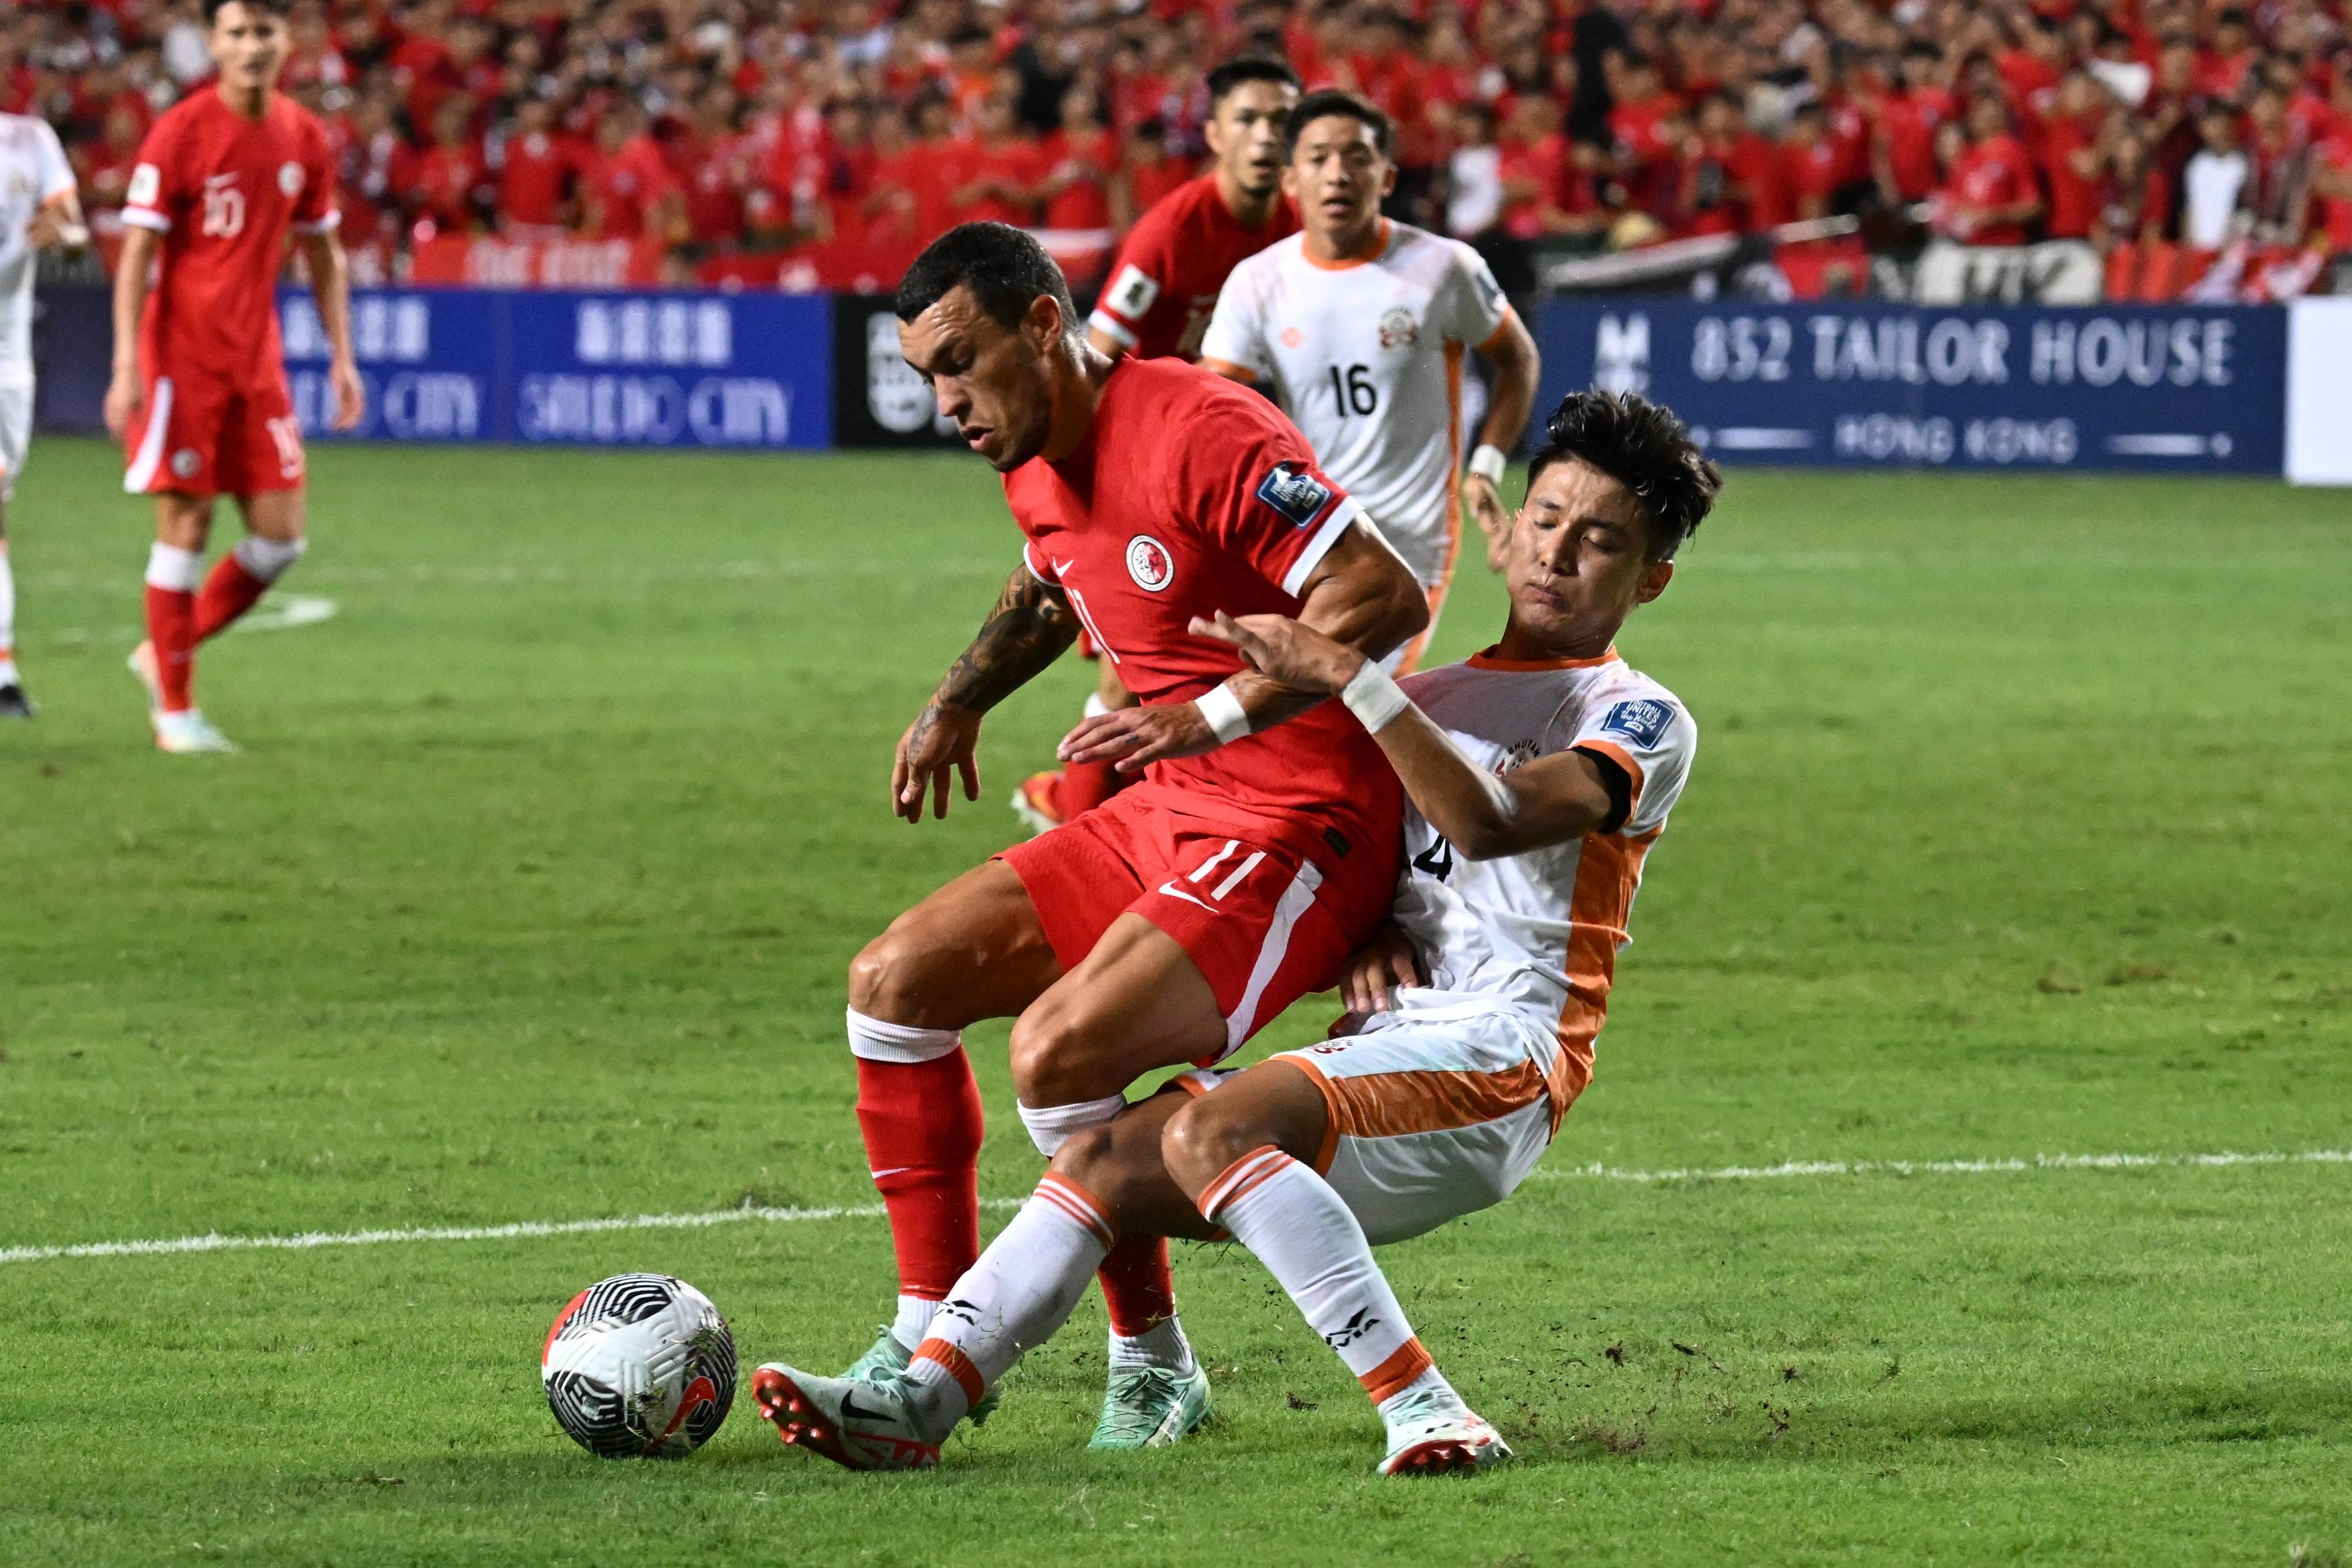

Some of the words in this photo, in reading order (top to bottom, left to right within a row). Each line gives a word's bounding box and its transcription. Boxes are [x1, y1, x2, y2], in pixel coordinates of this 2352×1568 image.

[203, 186, 246, 239] 10
[1690, 316, 1792, 382] 852
[1807, 315, 2010, 386] TAILOR
[2030, 317, 2236, 387] HOUSE
[1330, 363, 1377, 416] 16
[1836, 413, 1955, 464] HONG
[1963, 416, 2078, 464] KONG
[1620, 709, 1634, 720] the
[1626, 700, 1660, 723] UNITES
[1632, 700, 1661, 718] OOTBALL
[1508, 739, 1542, 758] BHUTAN
[1188, 839, 1268, 901] 11
[1412, 834, 1453, 883] 4
